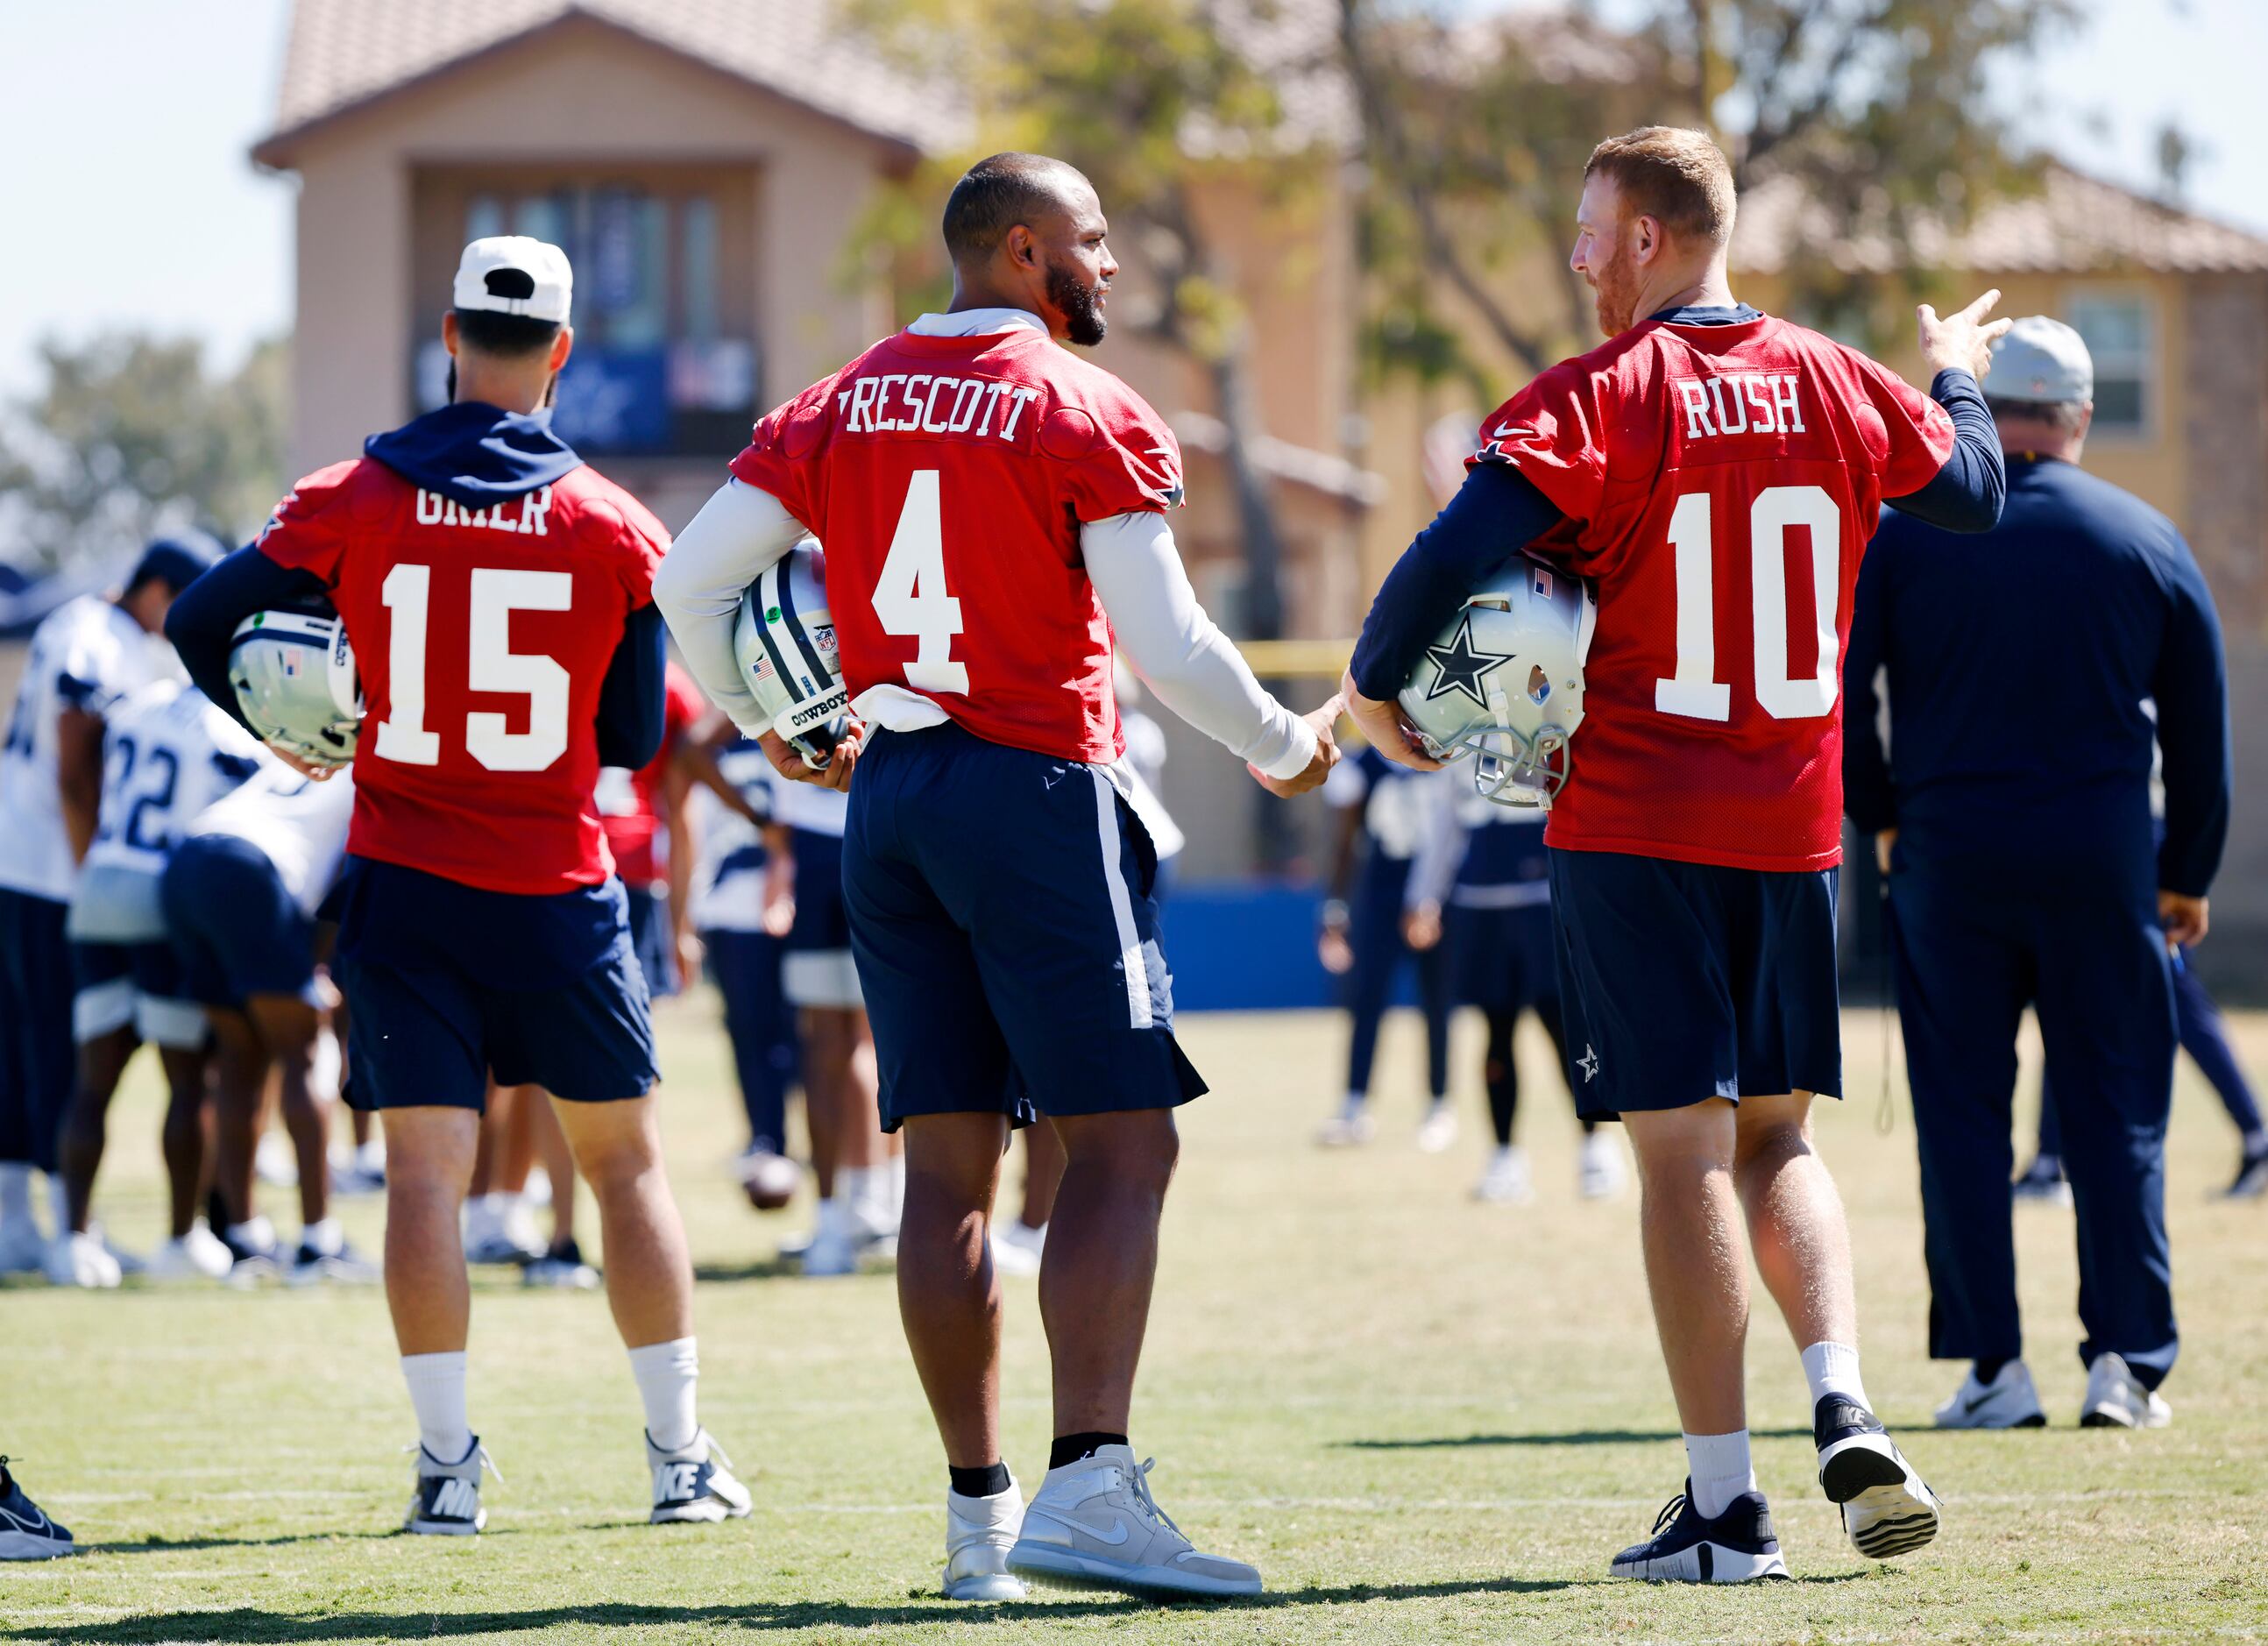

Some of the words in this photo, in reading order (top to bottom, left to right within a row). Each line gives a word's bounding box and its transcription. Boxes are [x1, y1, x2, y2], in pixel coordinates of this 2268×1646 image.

[1677, 375, 1806, 439] RUSH
[416, 484, 553, 536] GER
[871, 469, 970, 698] 4
[1655, 486, 1840, 722] 10
[374, 564, 572, 772] 15
[819, 637, 834, 649] NFL
[791, 689, 848, 727] COWBOY
